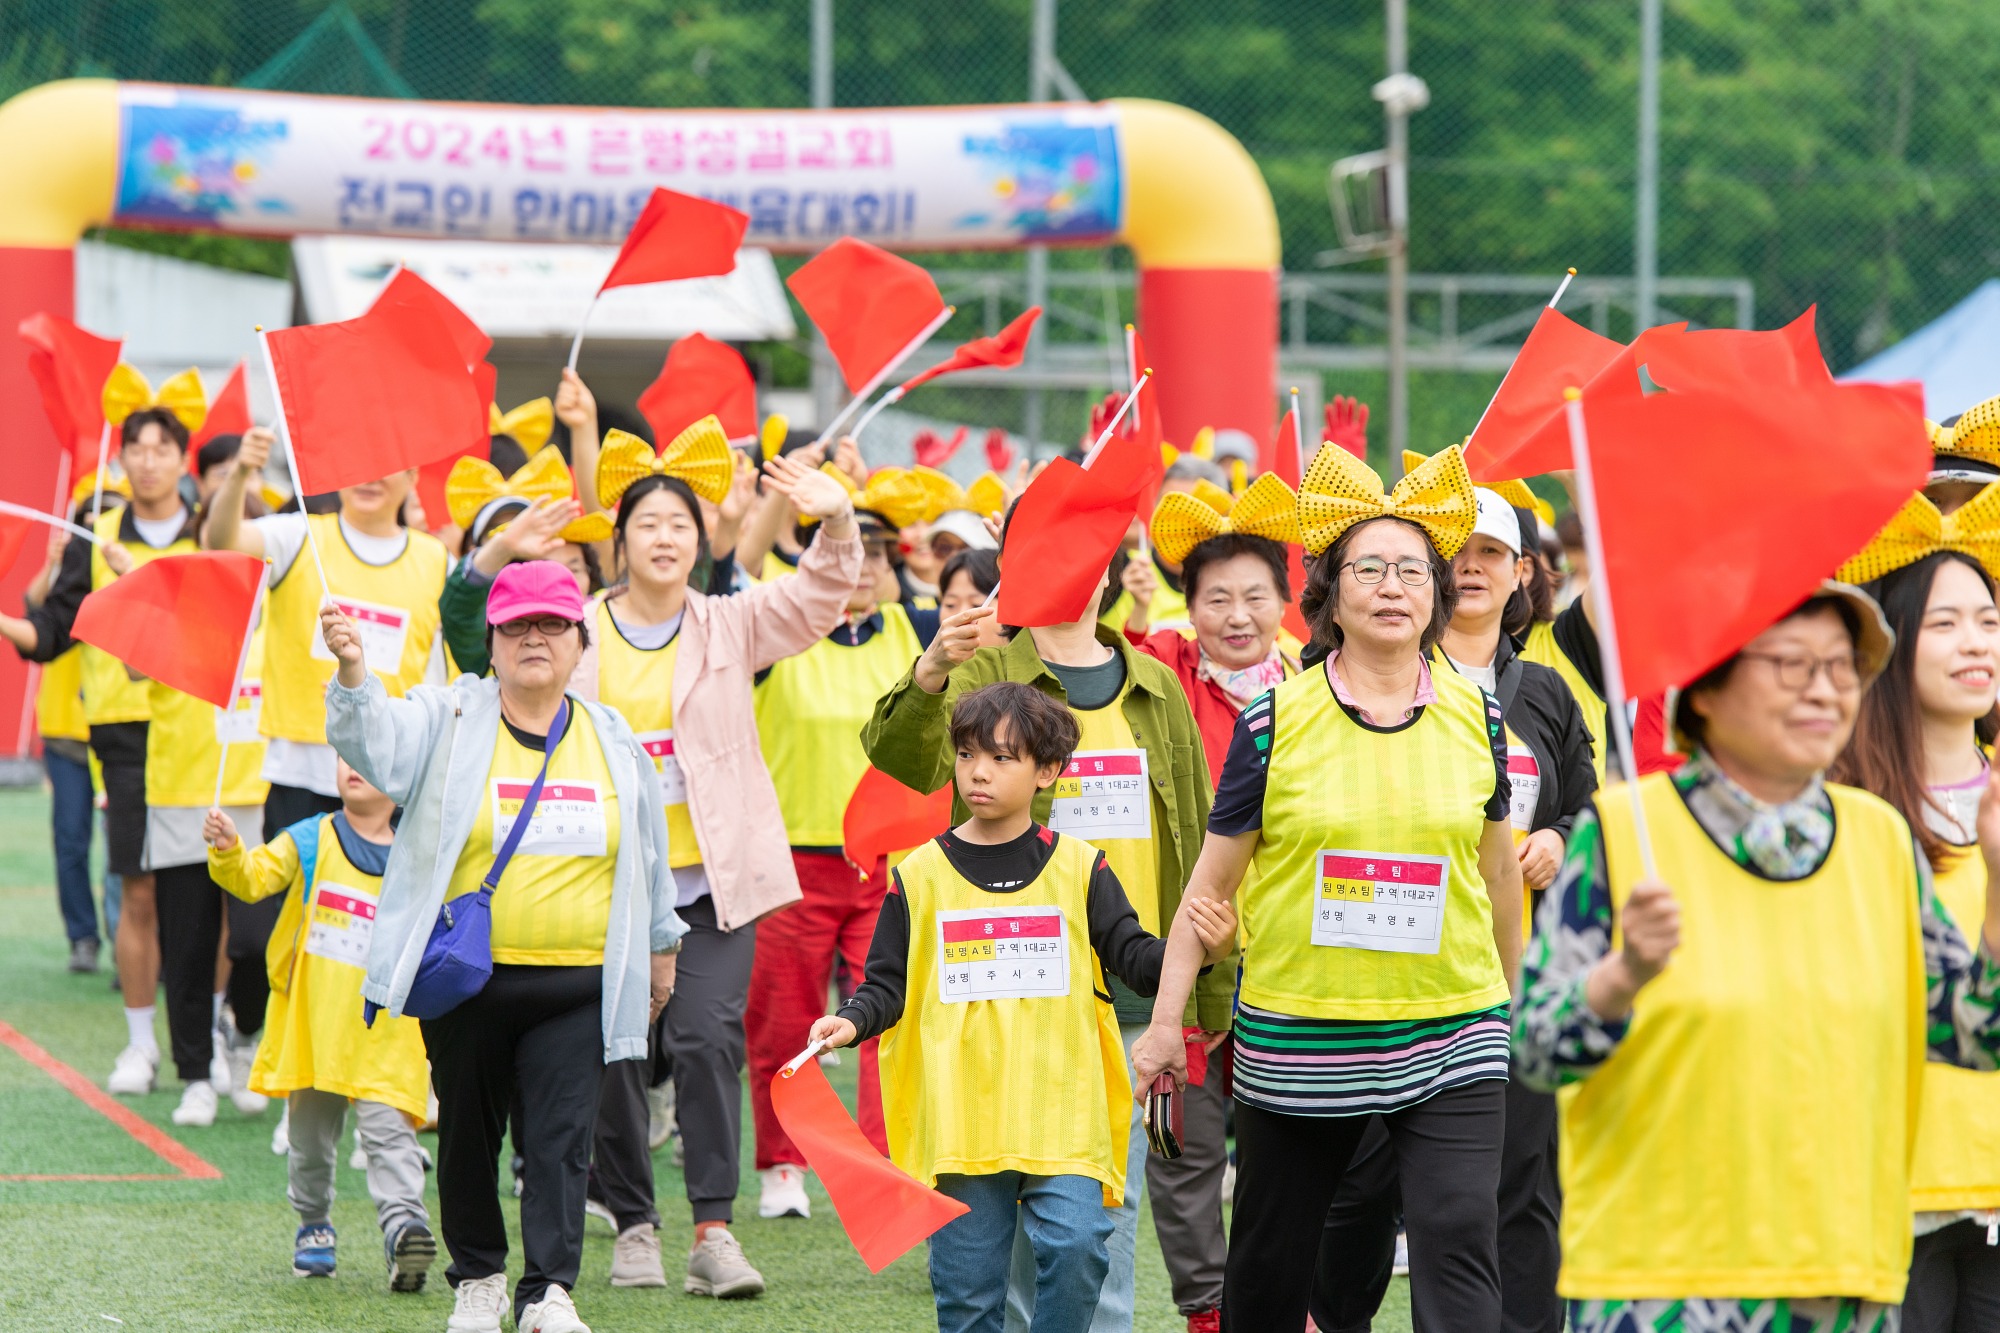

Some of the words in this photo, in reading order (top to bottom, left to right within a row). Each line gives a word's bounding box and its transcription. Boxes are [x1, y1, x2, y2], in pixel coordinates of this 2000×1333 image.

[364, 116, 567, 173] 2024년
[338, 175, 492, 237] 전교인
[1108, 780, 1139, 790] 1대교구
[1510, 778, 1538, 790] 대교구
[1402, 890, 1436, 901] 1대교구
[1024, 942, 1058, 953] 1대교구
